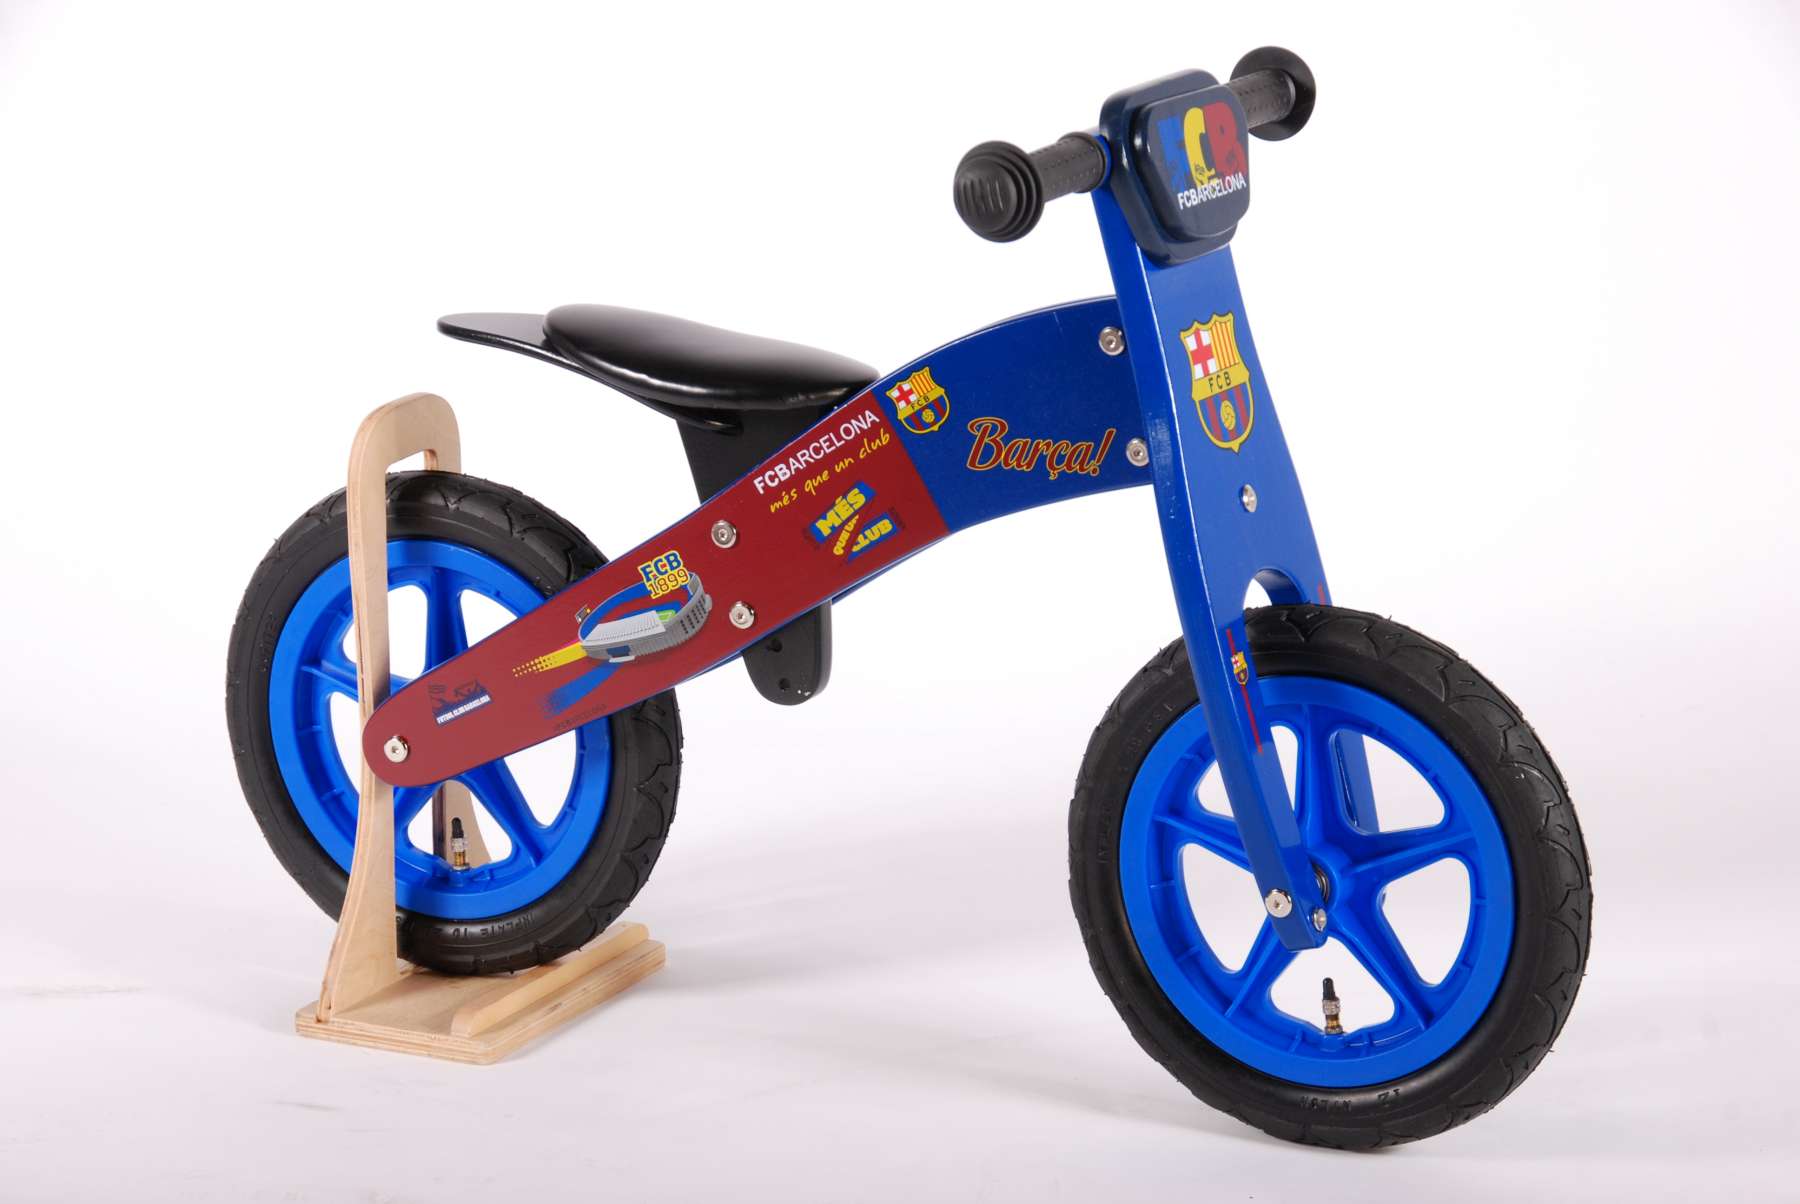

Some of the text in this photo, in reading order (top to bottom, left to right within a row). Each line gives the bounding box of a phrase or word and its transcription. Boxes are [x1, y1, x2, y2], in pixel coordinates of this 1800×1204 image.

[1177, 172, 1247, 210] FCBARCELONA
[1208, 371, 1232, 393] FCB
[911, 395, 930, 410] FCB
[753, 409, 881, 495] FCBARCELONA
[967, 416, 1117, 480] Barça!
[769, 428, 891, 513] més que un club
[815, 487, 866, 537] MÉS
[637, 550, 683, 583] FCB
[648, 567, 690, 599] 1899
